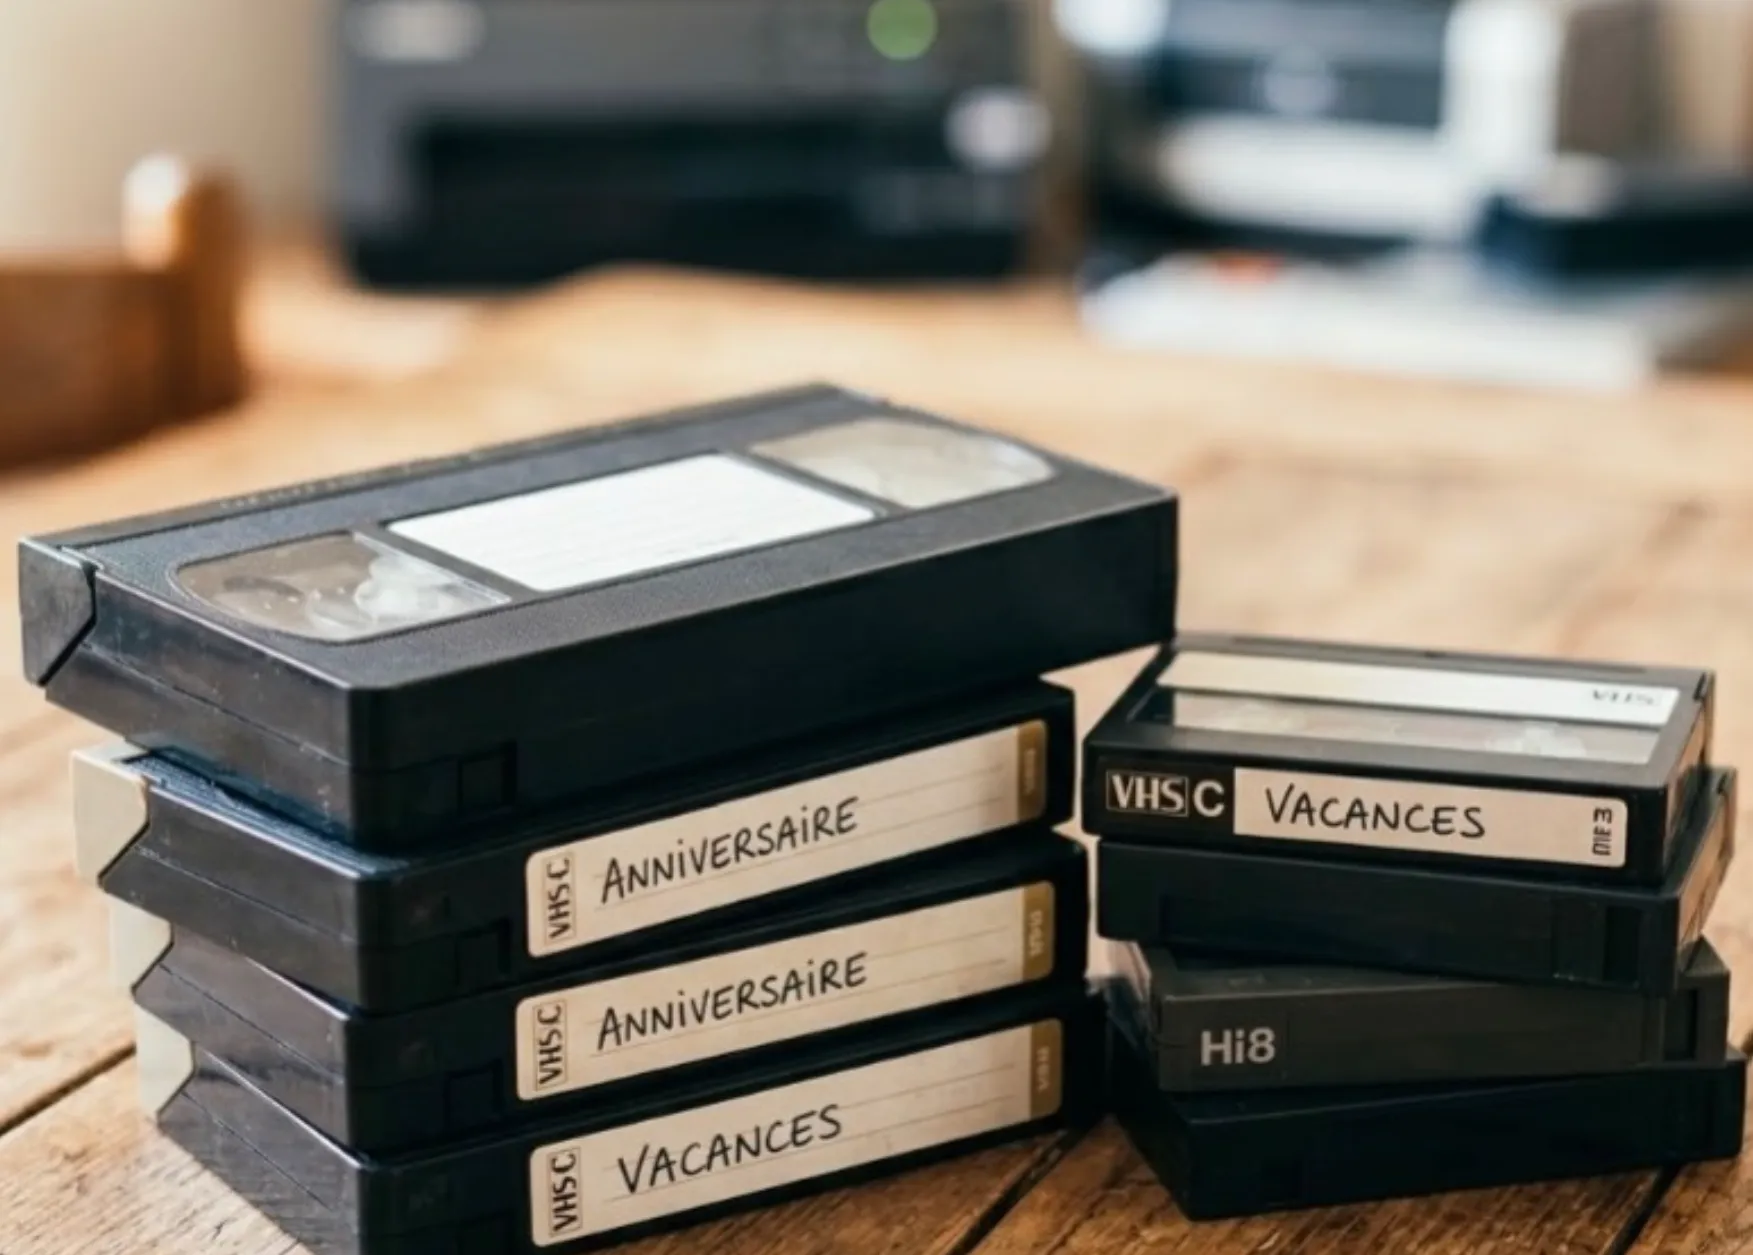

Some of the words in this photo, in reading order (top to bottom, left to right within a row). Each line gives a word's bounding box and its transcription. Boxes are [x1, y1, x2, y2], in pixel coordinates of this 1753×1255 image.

[1111, 774, 1185, 812] VHS
[1266, 784, 1486, 839] VACANCES
[1201, 1027, 1276, 1067] Hi8
[617, 1104, 842, 1194] VACANCES
